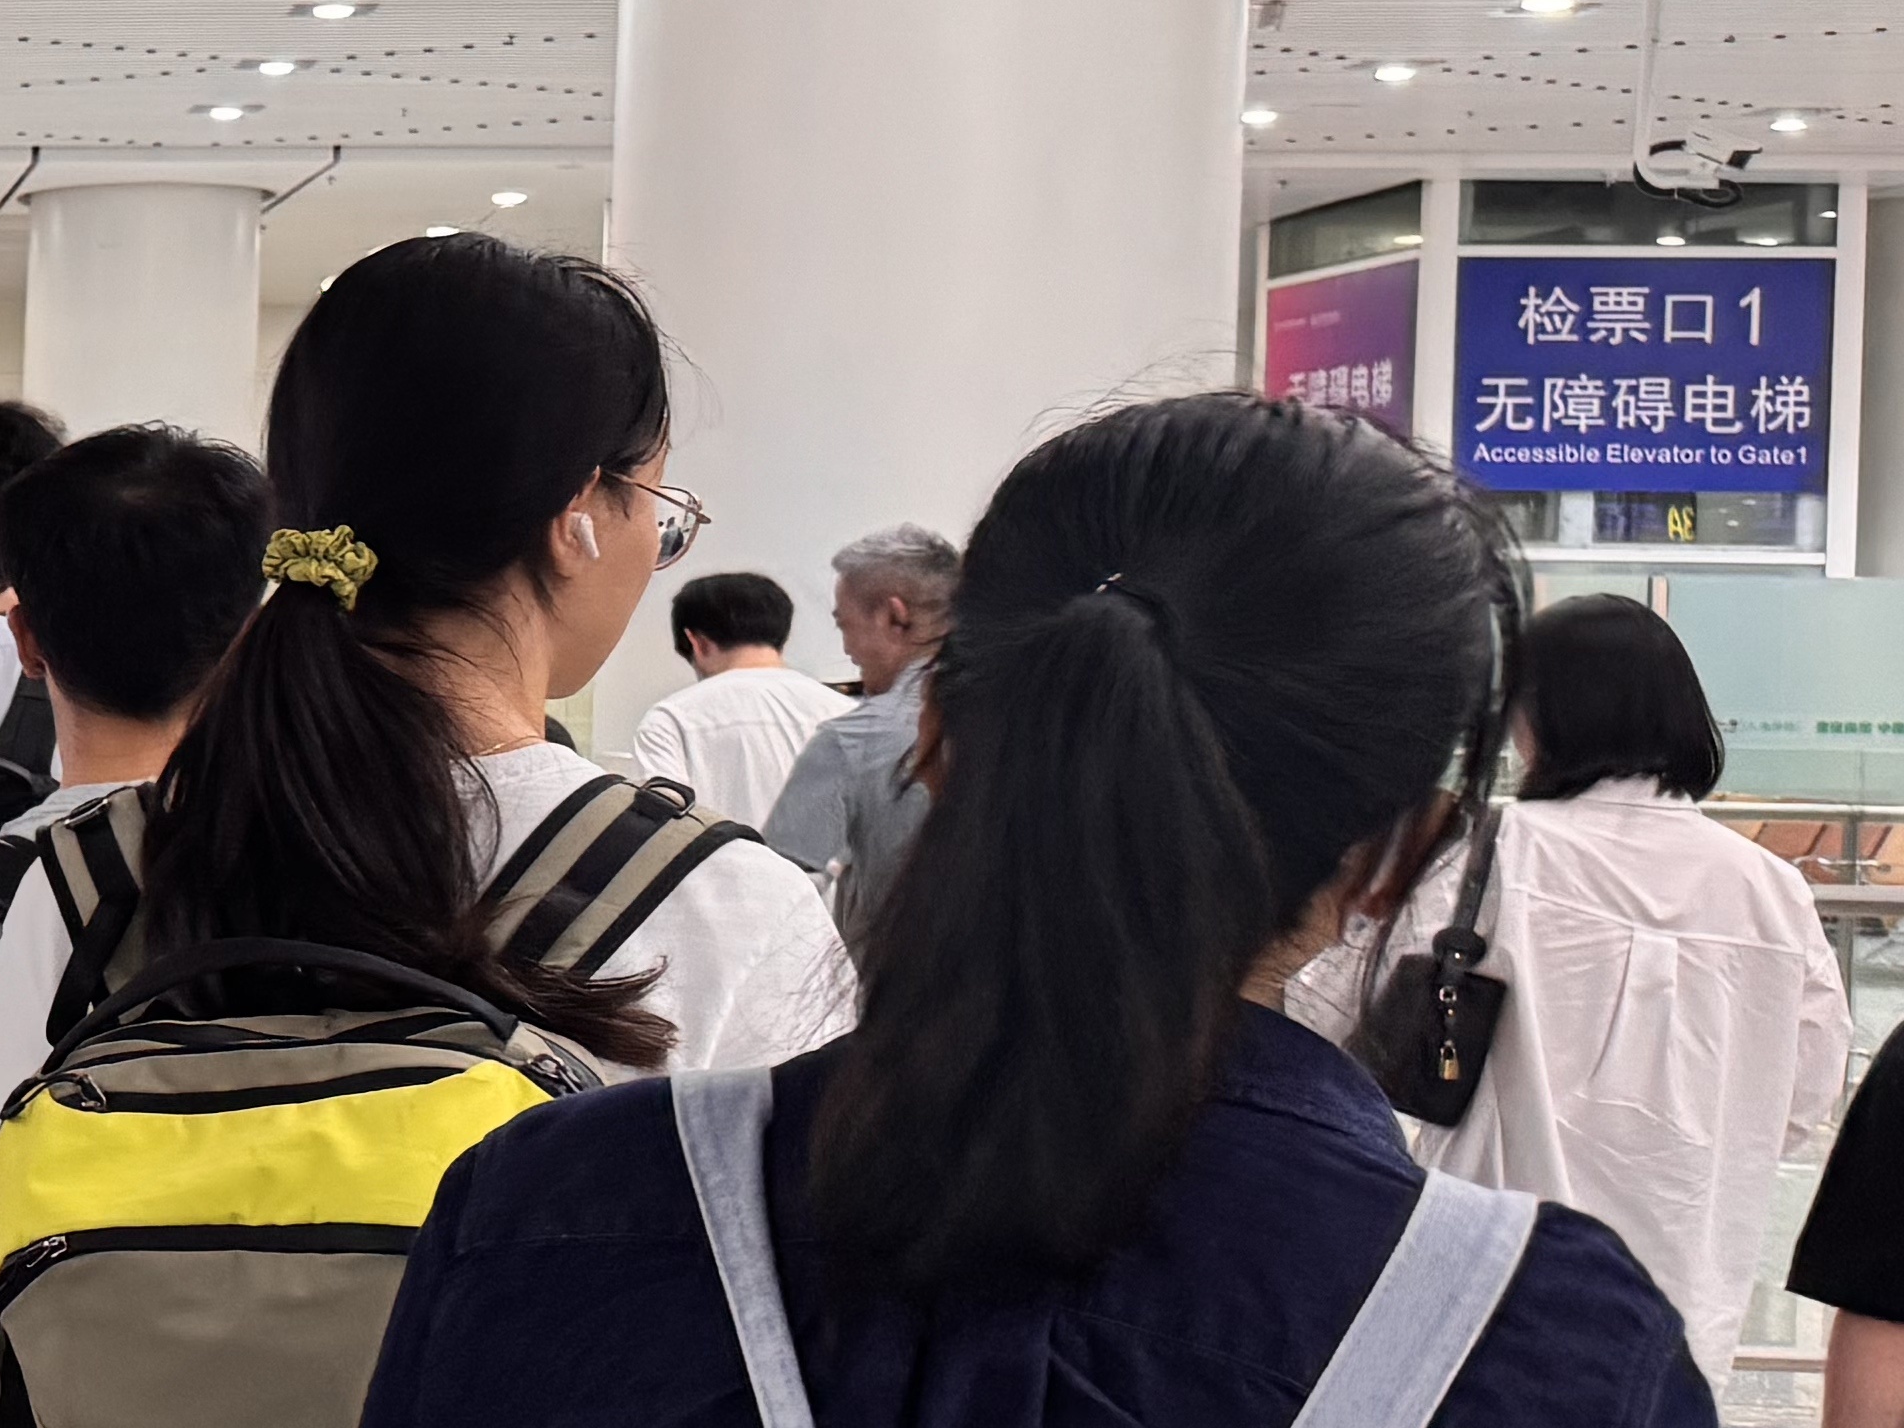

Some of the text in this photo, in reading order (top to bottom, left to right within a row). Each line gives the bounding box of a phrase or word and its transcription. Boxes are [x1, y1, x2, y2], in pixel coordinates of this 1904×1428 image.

[1518, 286, 1762, 346] 检票口 1
[1475, 374, 1811, 434] 无障碍电梯
[1473, 442, 1600, 464] Accessible
[1607, 442, 1704, 464] Elevator
[1710, 443, 1732, 464] to
